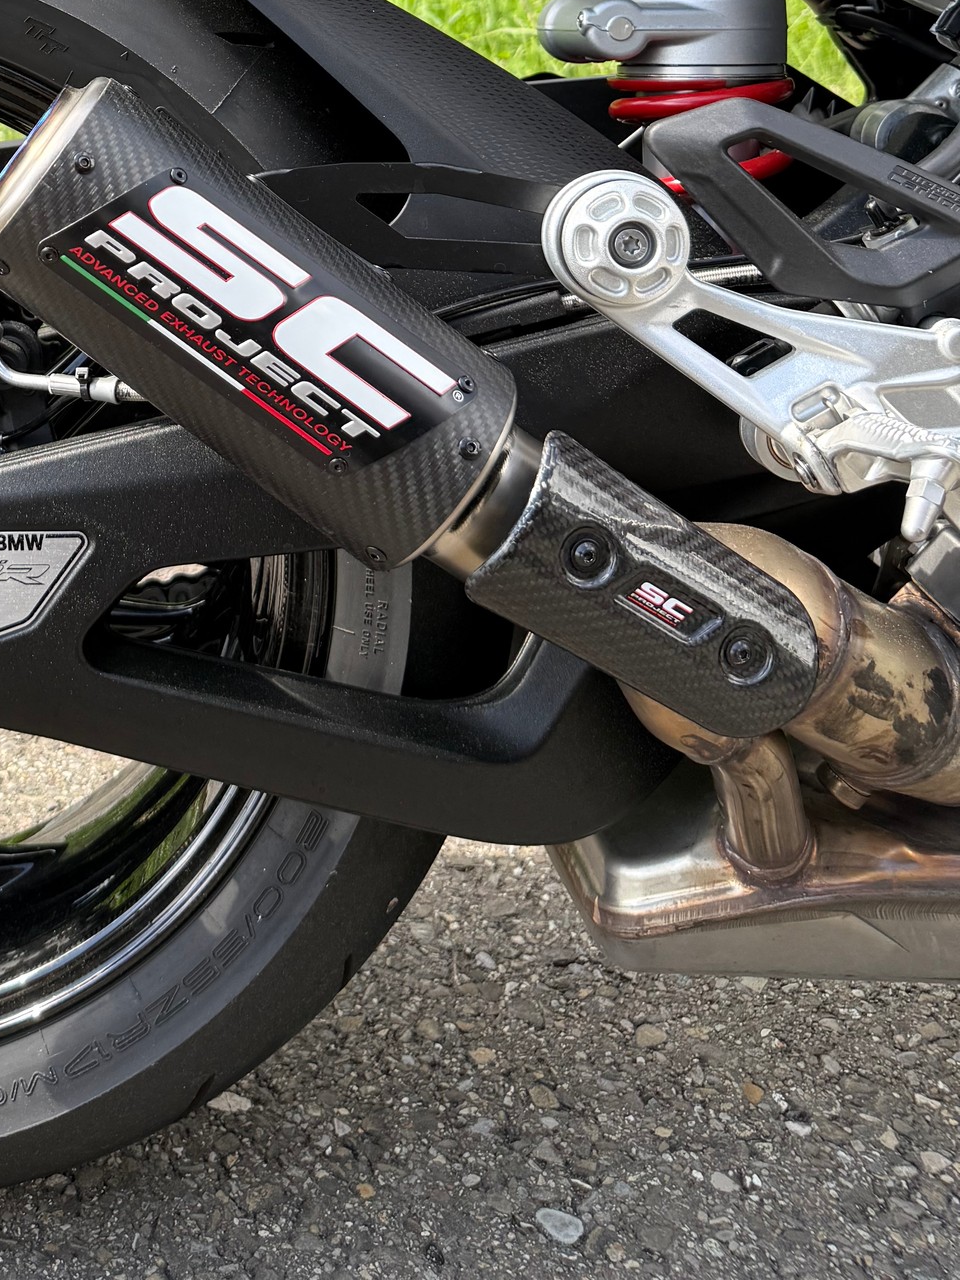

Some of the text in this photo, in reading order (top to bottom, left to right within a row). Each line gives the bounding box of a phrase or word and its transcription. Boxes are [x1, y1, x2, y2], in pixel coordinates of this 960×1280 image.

[68, 245, 353, 452] ADVANCED EXHAUST TECHNOLOGY
[83, 228, 382, 439] PROJECT
[108, 185, 459, 432] SC
[358, 567, 375, 659] HEEL USE ONLY
[372, 599, 389, 655] RADIAL
[630, 592, 681, 624] PROJECT
[634, 581, 695, 621] SC
